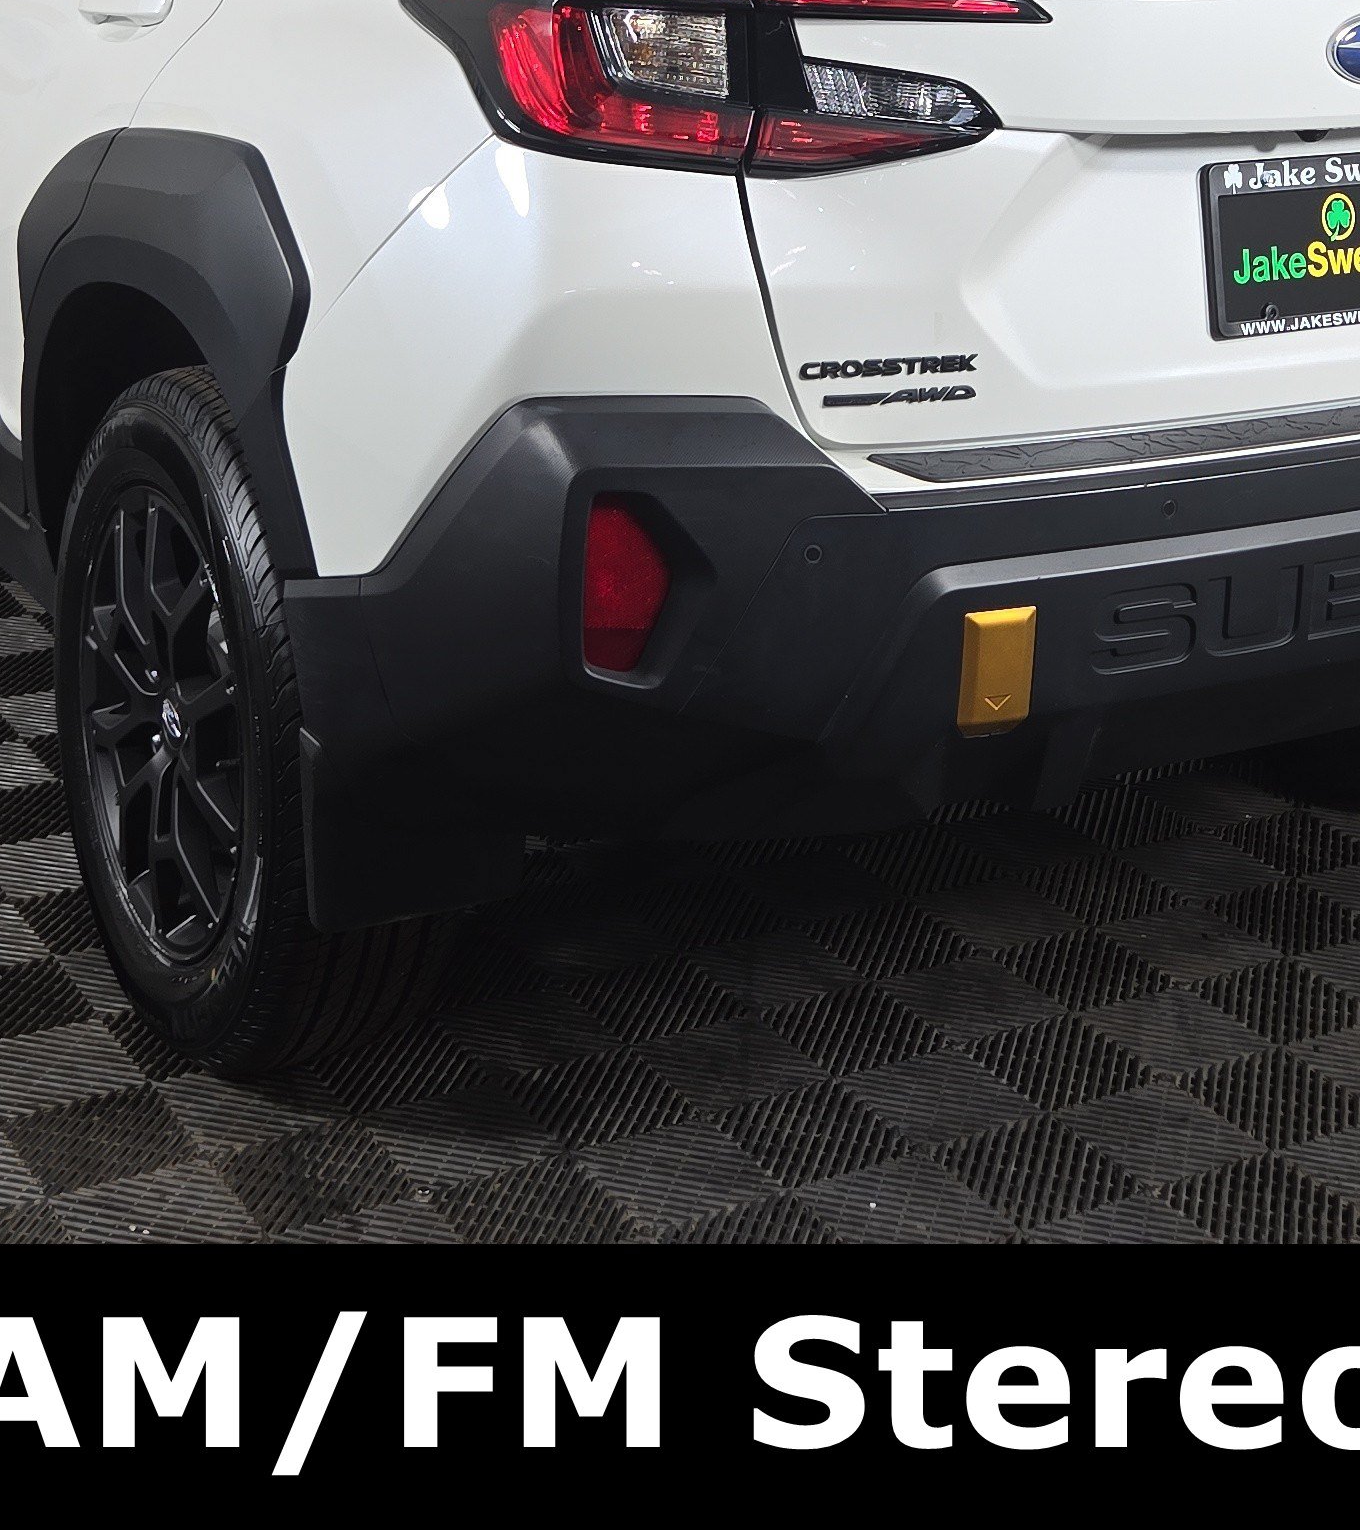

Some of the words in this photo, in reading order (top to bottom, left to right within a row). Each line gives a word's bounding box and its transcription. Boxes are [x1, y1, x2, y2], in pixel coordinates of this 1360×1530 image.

[1248, 160, 1316, 190] Jake
[798, 353, 979, 380] CROSSTREK
[880, 384, 977, 405] AWD
